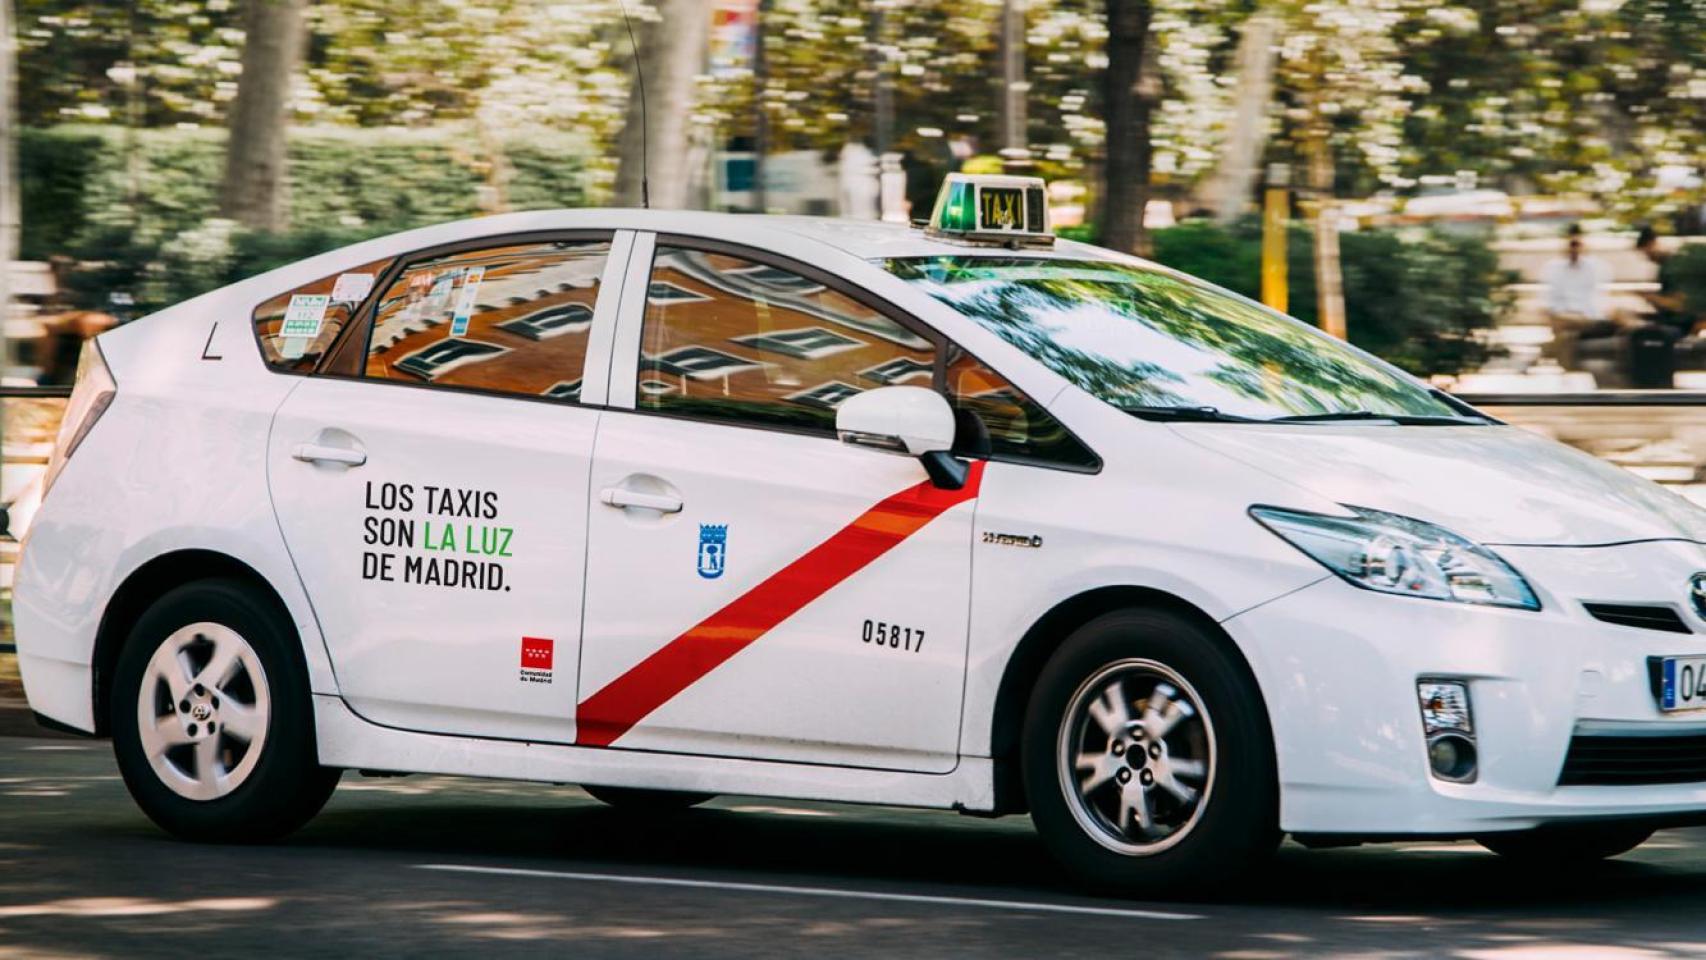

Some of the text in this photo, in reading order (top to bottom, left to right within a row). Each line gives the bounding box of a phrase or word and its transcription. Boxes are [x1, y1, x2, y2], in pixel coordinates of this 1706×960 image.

[982, 192, 1022, 225] TAXI
[366, 481, 498, 519] LOS TAXIS
[364, 516, 513, 556] SON LA LUZ
[362, 552, 511, 592] DE MADRID.
[862, 619, 925, 653] 05817
[529, 676, 552, 684] Madrid
